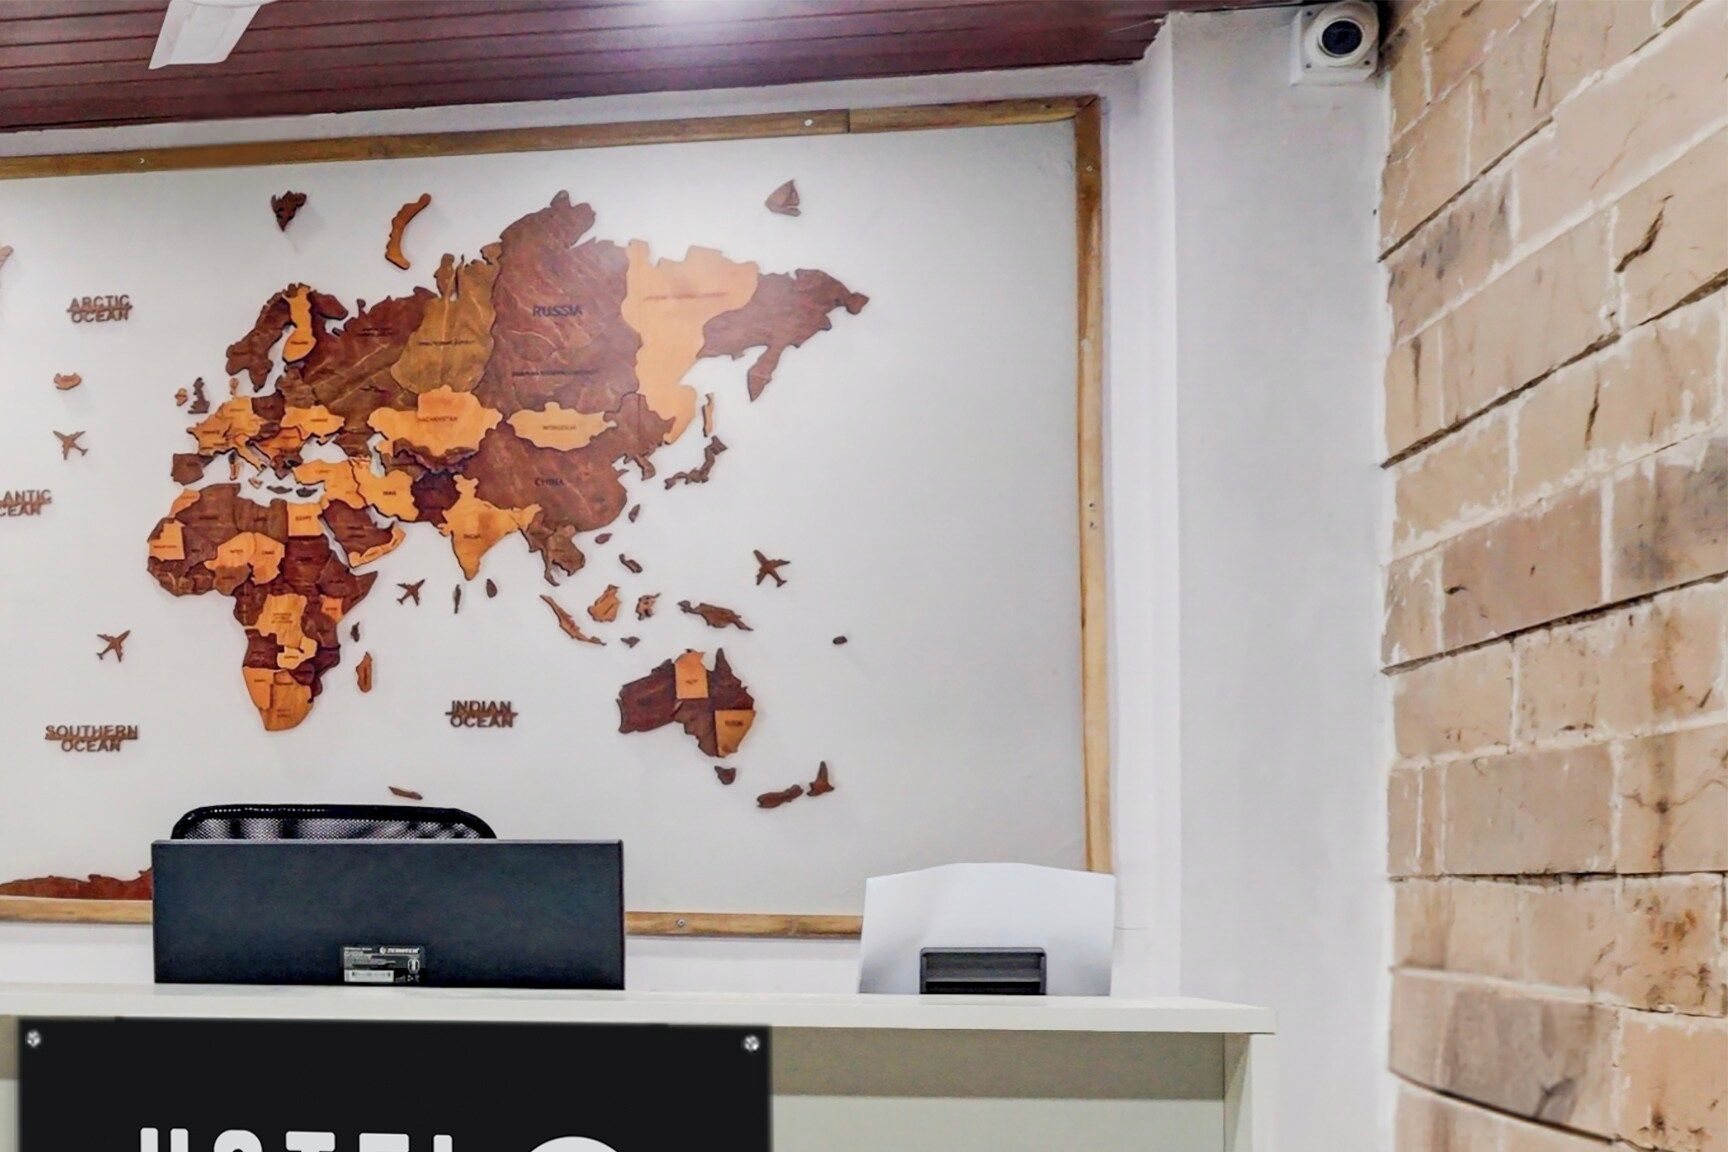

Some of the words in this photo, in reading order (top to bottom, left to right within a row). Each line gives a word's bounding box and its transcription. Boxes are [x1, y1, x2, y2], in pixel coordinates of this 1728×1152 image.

[68, 294, 132, 310] ARCTIC
[71, 308, 129, 323] OCEAN
[532, 304, 583, 317] RUSSIA
[451, 700, 512, 714] INDIAN
[450, 714, 514, 728] OCEAN
[45, 725, 138, 740] SOUTHERN
[61, 739, 121, 752] OCEAN
